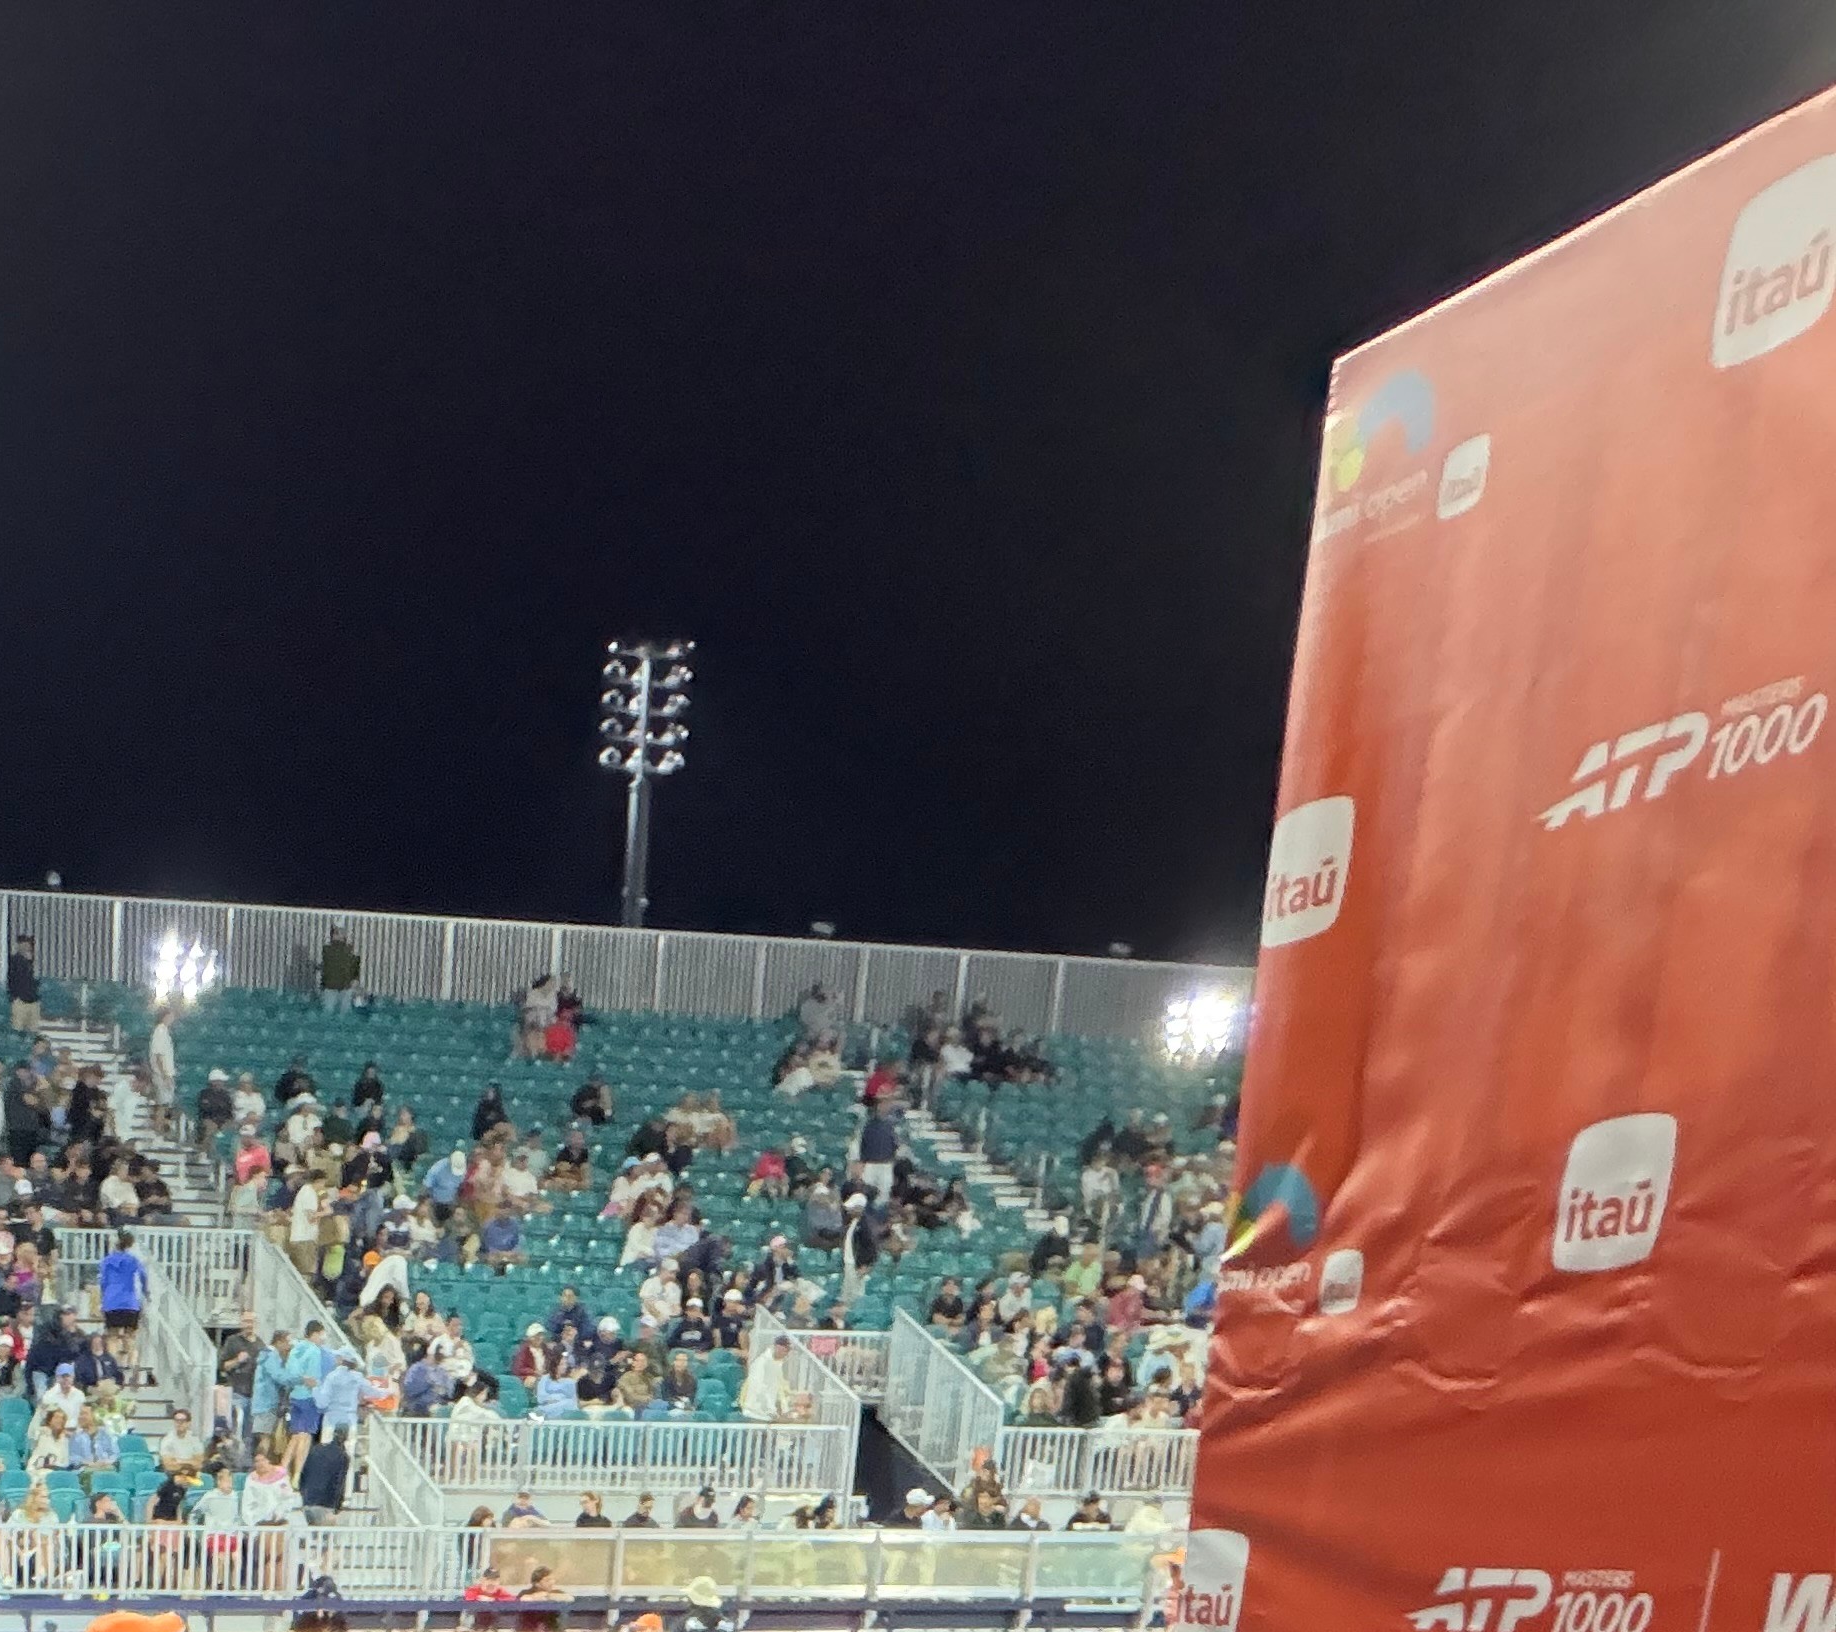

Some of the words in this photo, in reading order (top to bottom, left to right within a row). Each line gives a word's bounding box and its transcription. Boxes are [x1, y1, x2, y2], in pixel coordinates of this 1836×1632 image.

[1724, 226, 1830, 336] itaú
[1533, 711, 1711, 831] ATP
[1706, 692, 1829, 782] 1000
[1564, 1178, 1655, 1243] itaú
